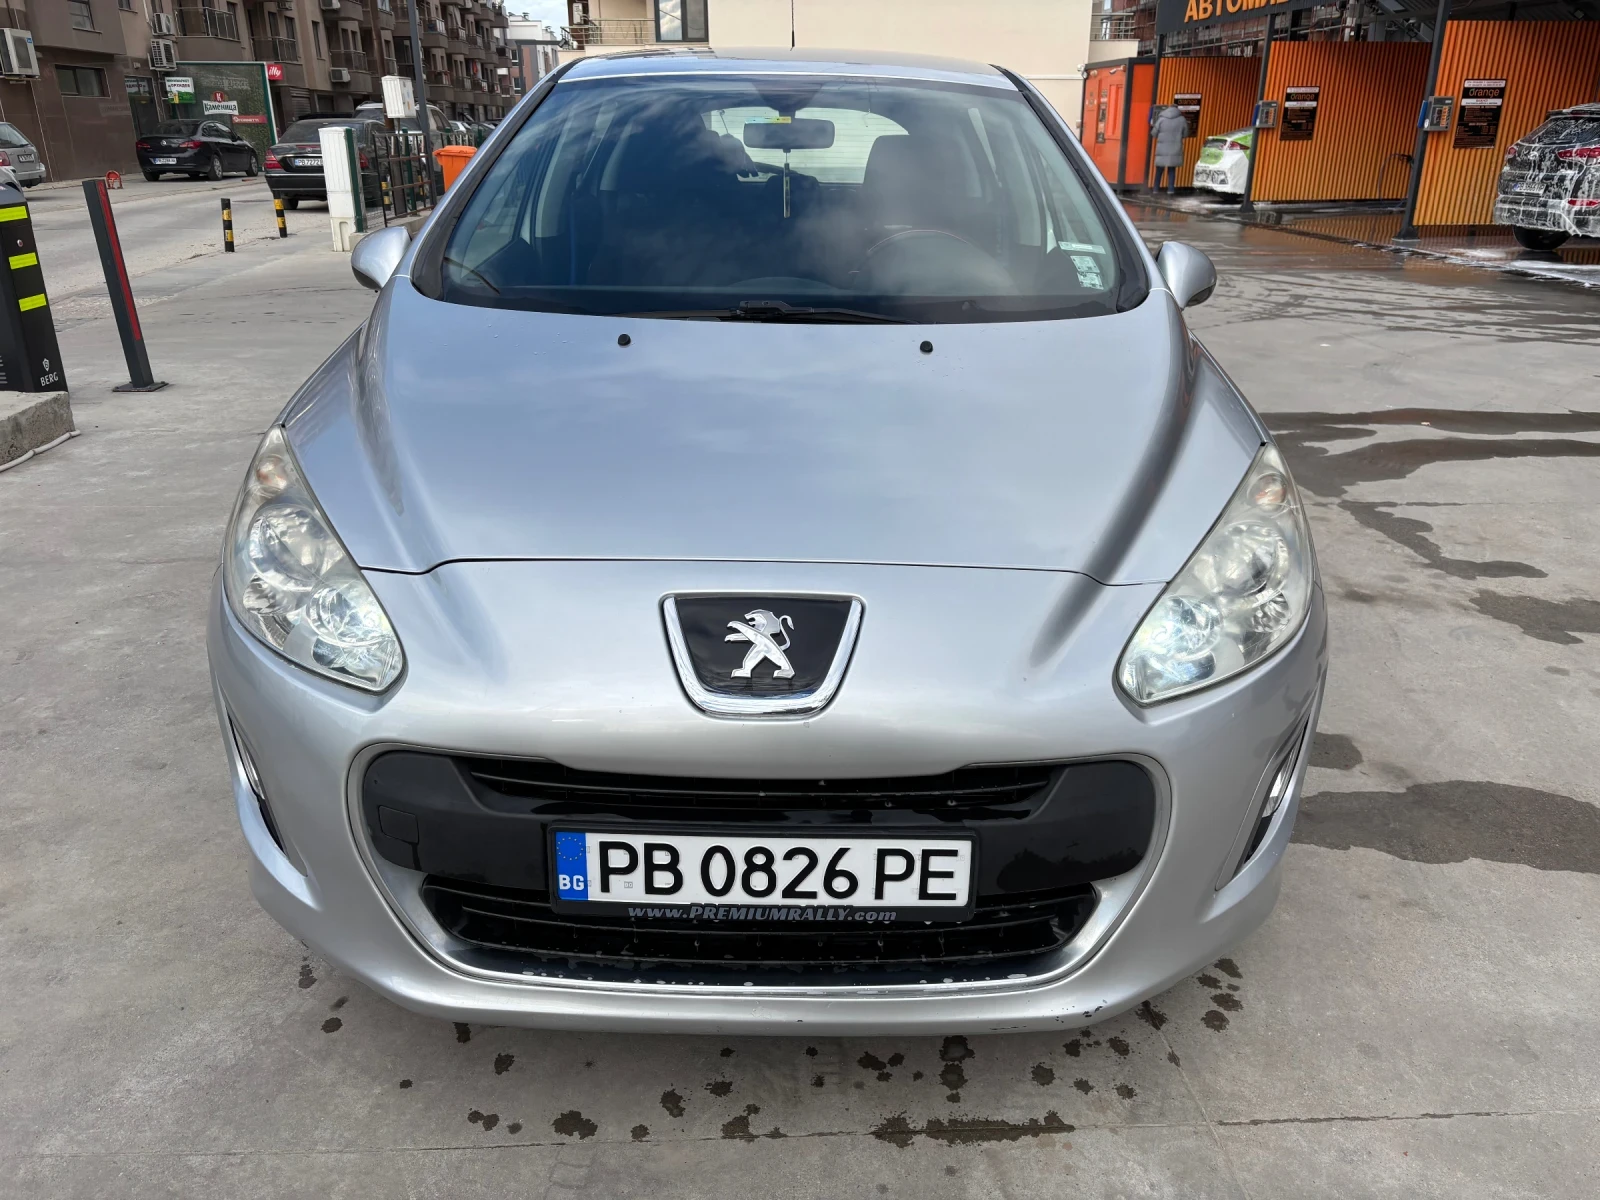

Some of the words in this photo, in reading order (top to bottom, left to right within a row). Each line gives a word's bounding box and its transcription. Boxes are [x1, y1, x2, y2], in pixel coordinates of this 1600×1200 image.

[1183, 0, 1289, 23] АВТО
[268, 66, 281, 77] illy
[203, 103, 237, 113] Каменица
[40, 372, 58, 386] BERG
[558, 874, 585, 890] BG
[599, 841, 684, 895] PB
[700, 844, 859, 900] 0826
[874, 848, 959, 900] PE
[627, 904, 897, 921] www.PREMIUMRALLY.com
